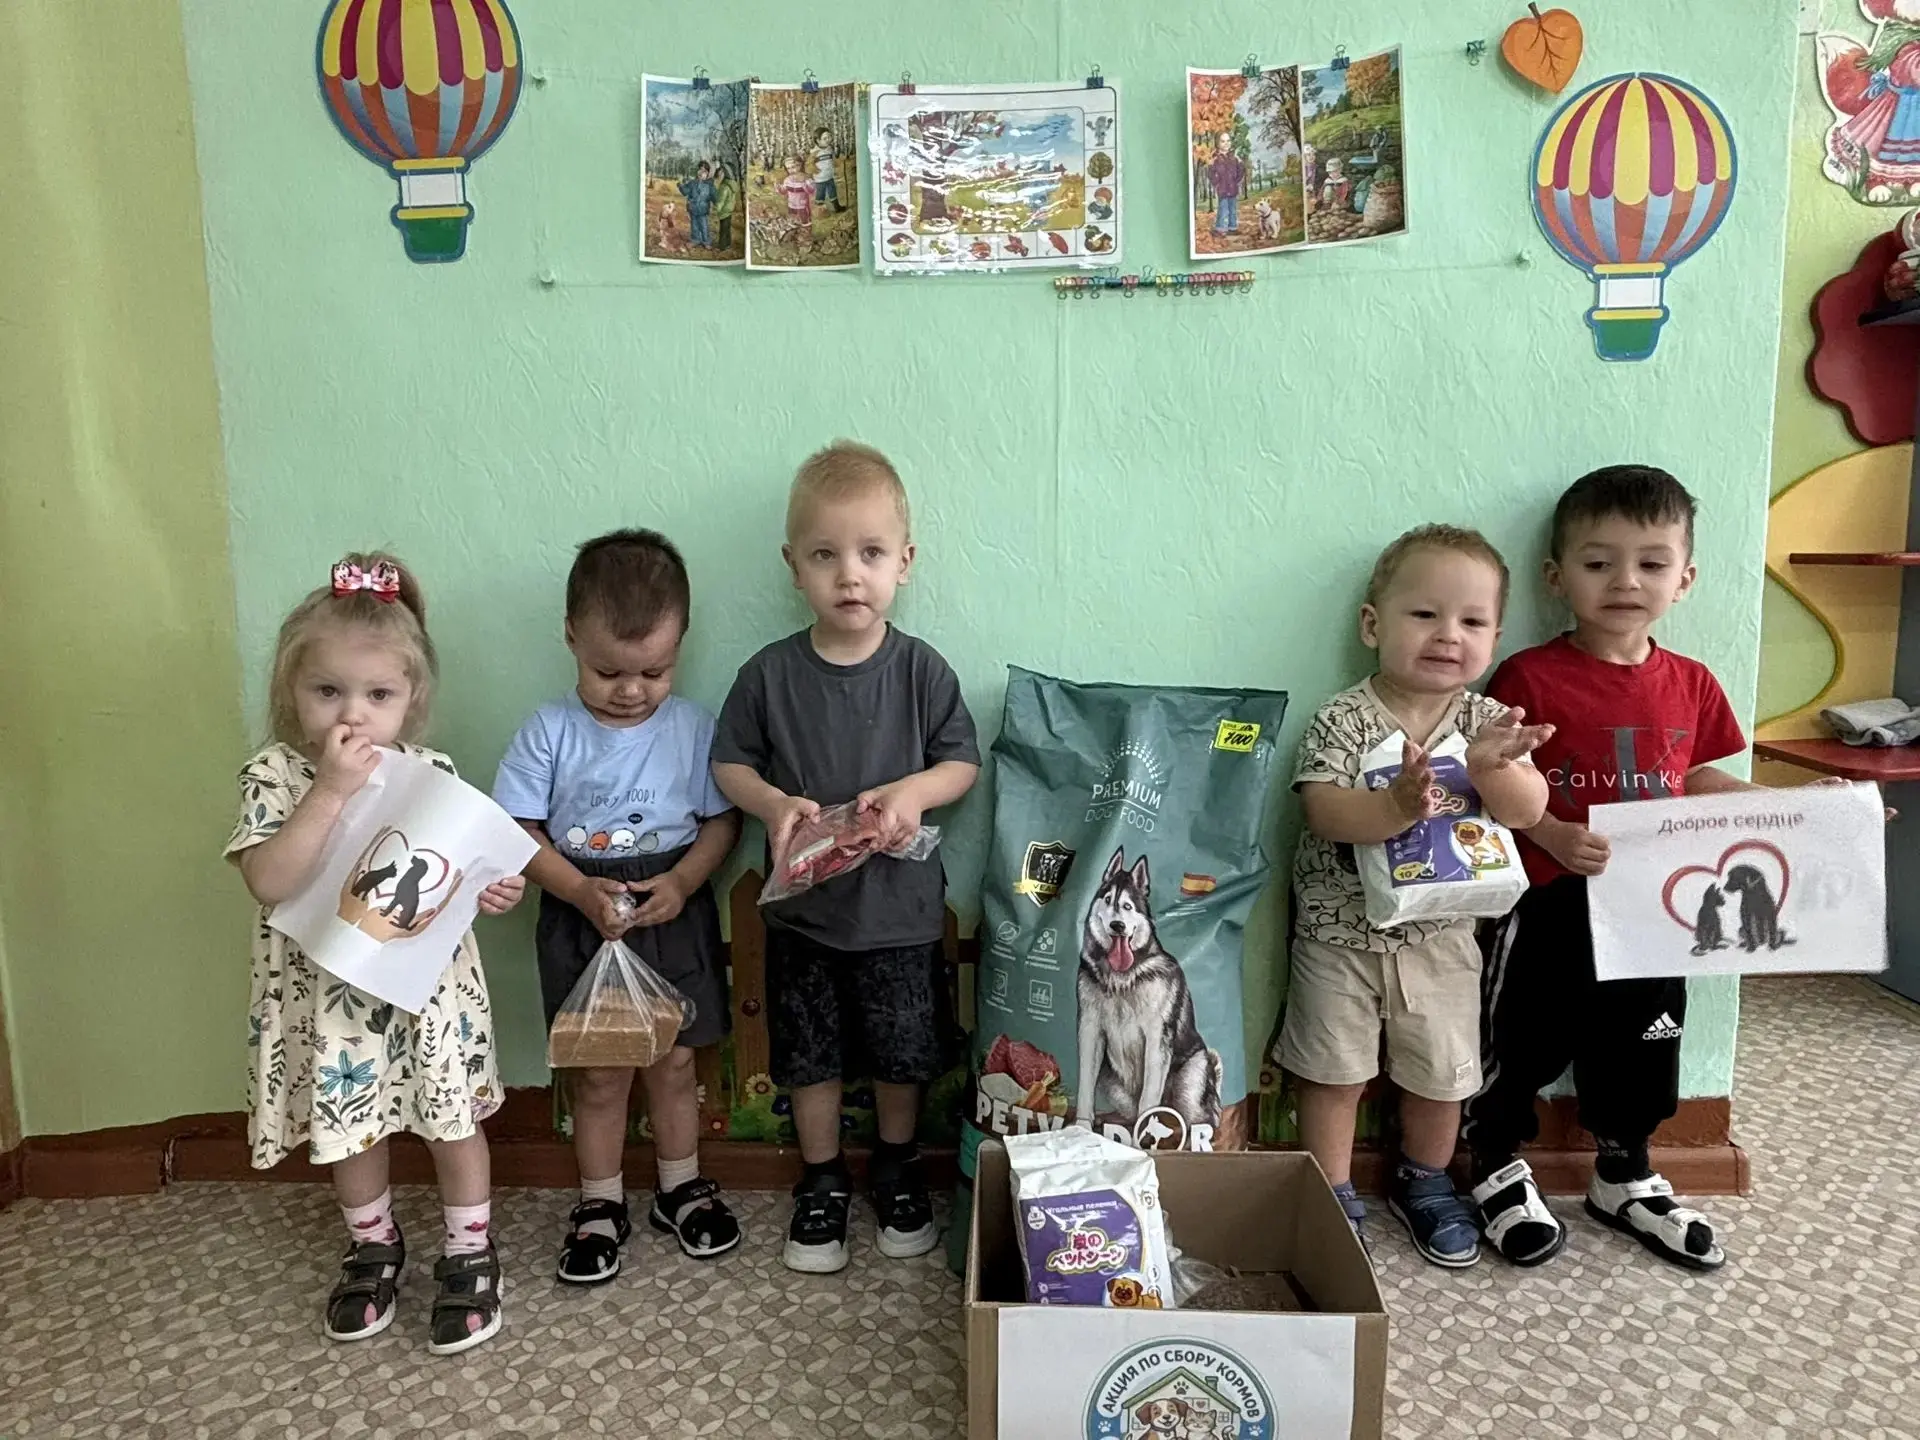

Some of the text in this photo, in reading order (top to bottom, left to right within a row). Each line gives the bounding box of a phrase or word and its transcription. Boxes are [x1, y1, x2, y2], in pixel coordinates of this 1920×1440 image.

[1546, 768, 1683, 789] Calvin Kle
[1091, 780, 1162, 810] PREMIUM
[1084, 805, 1155, 833] DOG FOOD
[1657, 811, 1805, 835] Доброе сердце
[1102, 1350, 1260, 1419] АКЦИЯ ПО СБОРУ КОРМОВ
